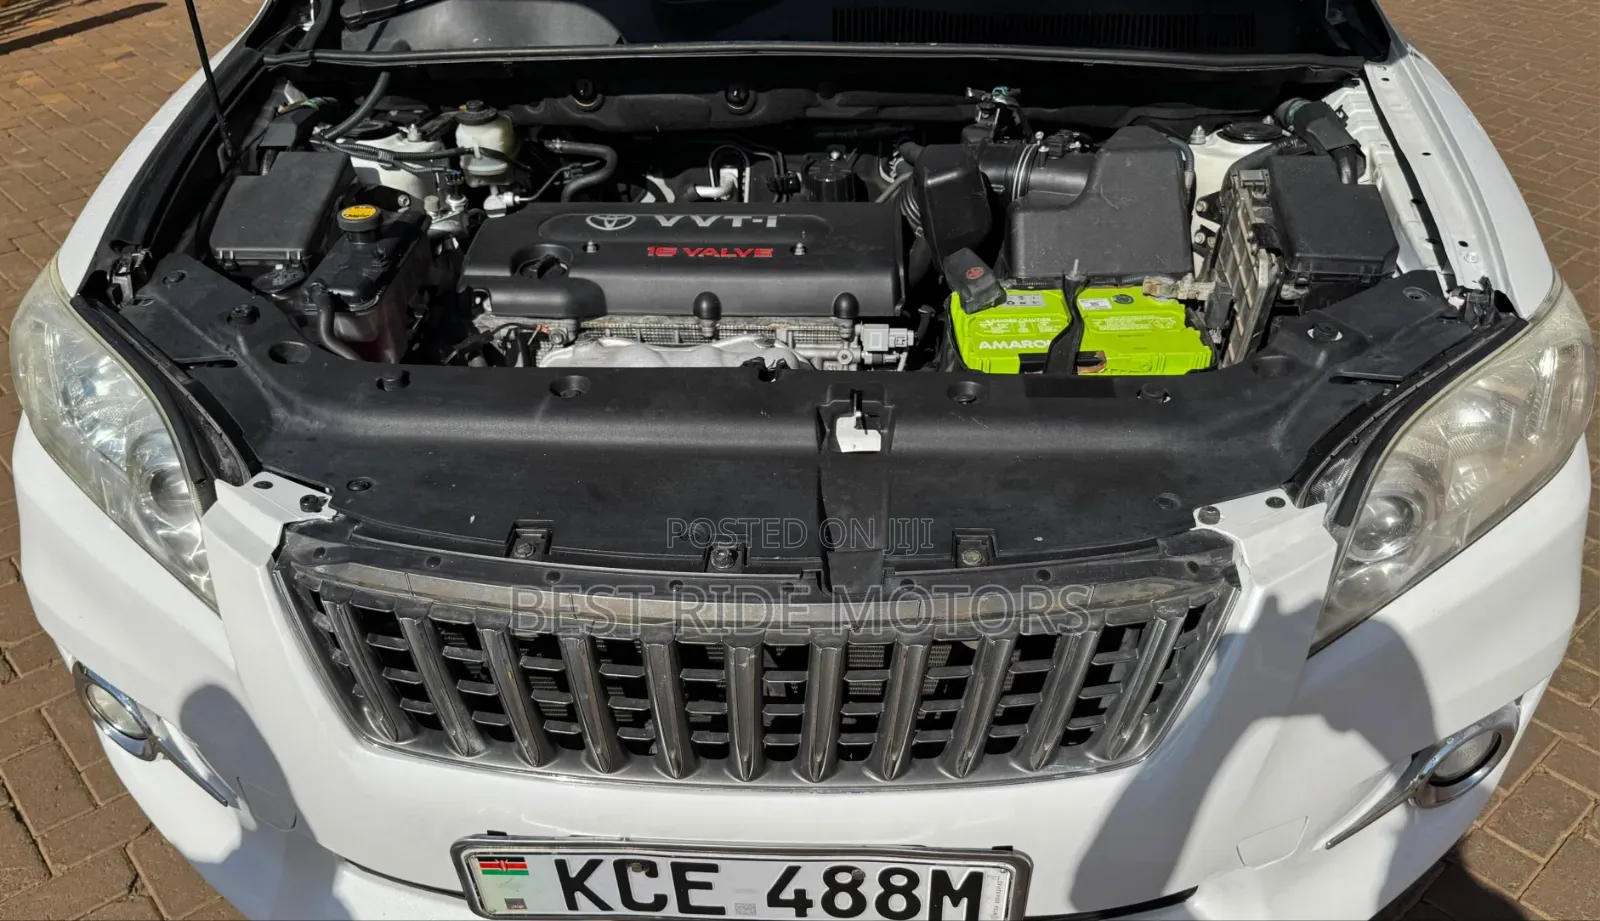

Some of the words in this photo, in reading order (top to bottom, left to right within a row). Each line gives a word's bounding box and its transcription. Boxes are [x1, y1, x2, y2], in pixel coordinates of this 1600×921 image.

[647, 247, 678, 257] 16
[682, 247, 774, 258] VALVE
[554, 858, 726, 916] KCE
[766, 864, 985, 921] 488M
